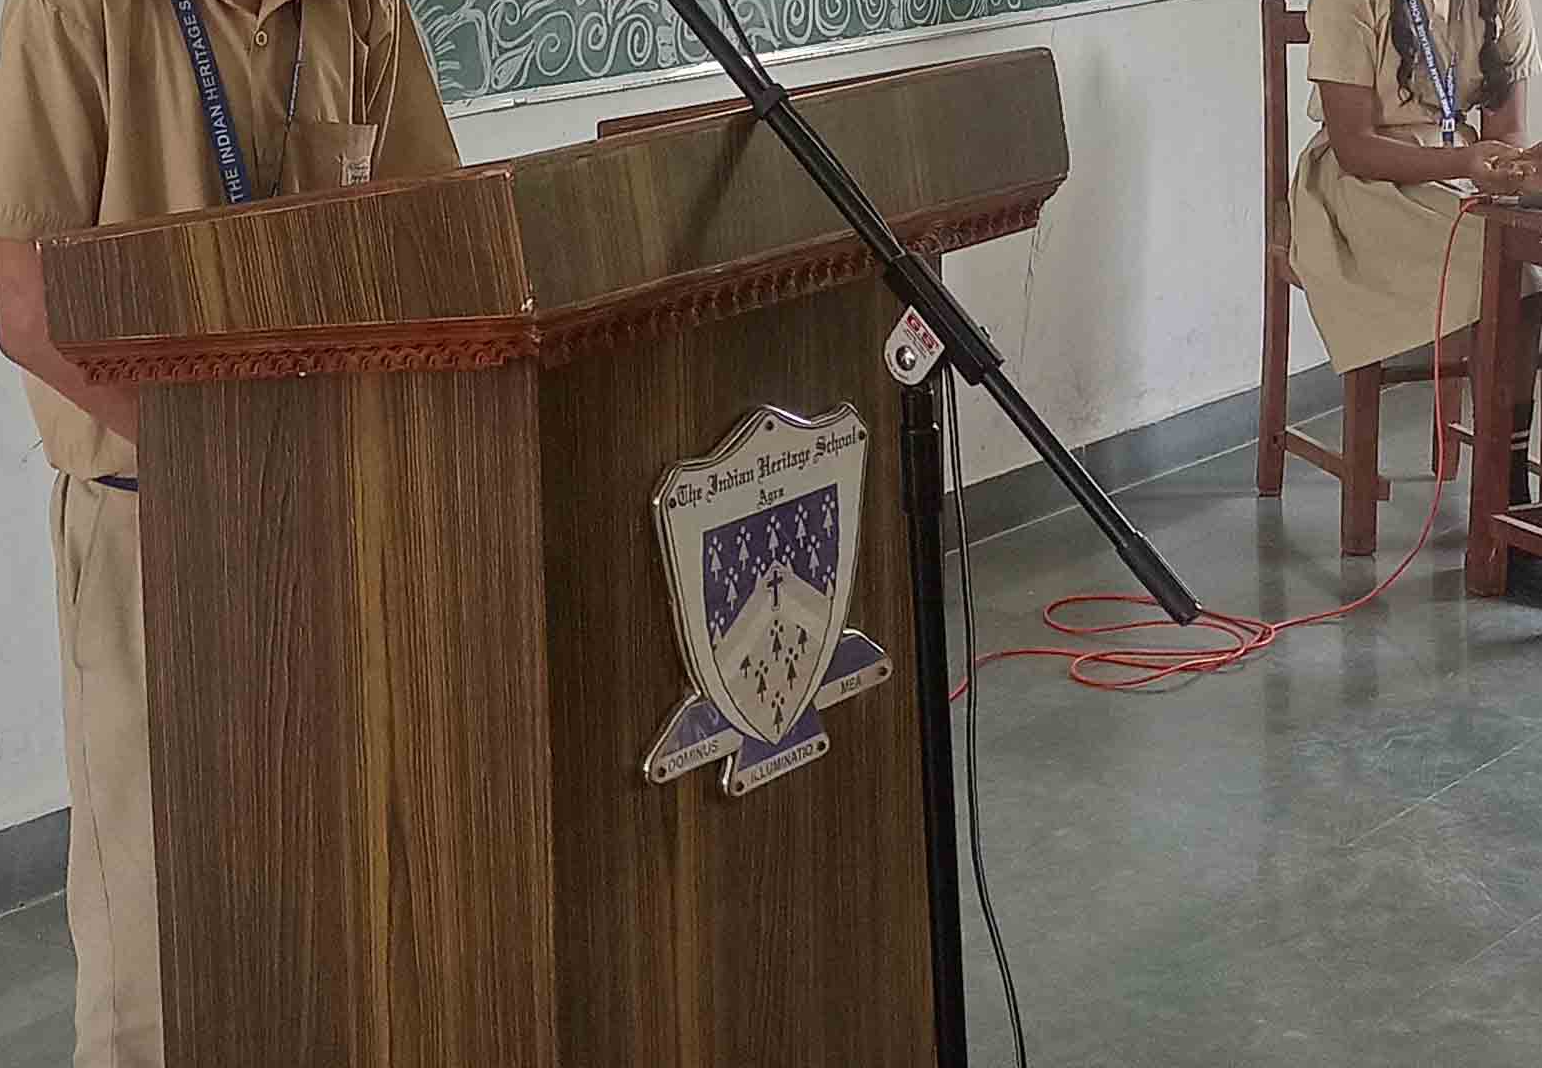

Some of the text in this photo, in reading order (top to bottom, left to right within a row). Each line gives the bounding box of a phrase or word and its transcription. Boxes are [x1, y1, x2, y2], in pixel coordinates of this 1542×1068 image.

[183, 12, 219, 100] HERITAGE
[210, 104, 236, 164] INDIAN
[225, 168, 244, 203] THE
[676, 426, 857, 508] The Indian Heritage School
[758, 487, 785, 508] Agra
[667, 738, 719, 773] DOMINUS
